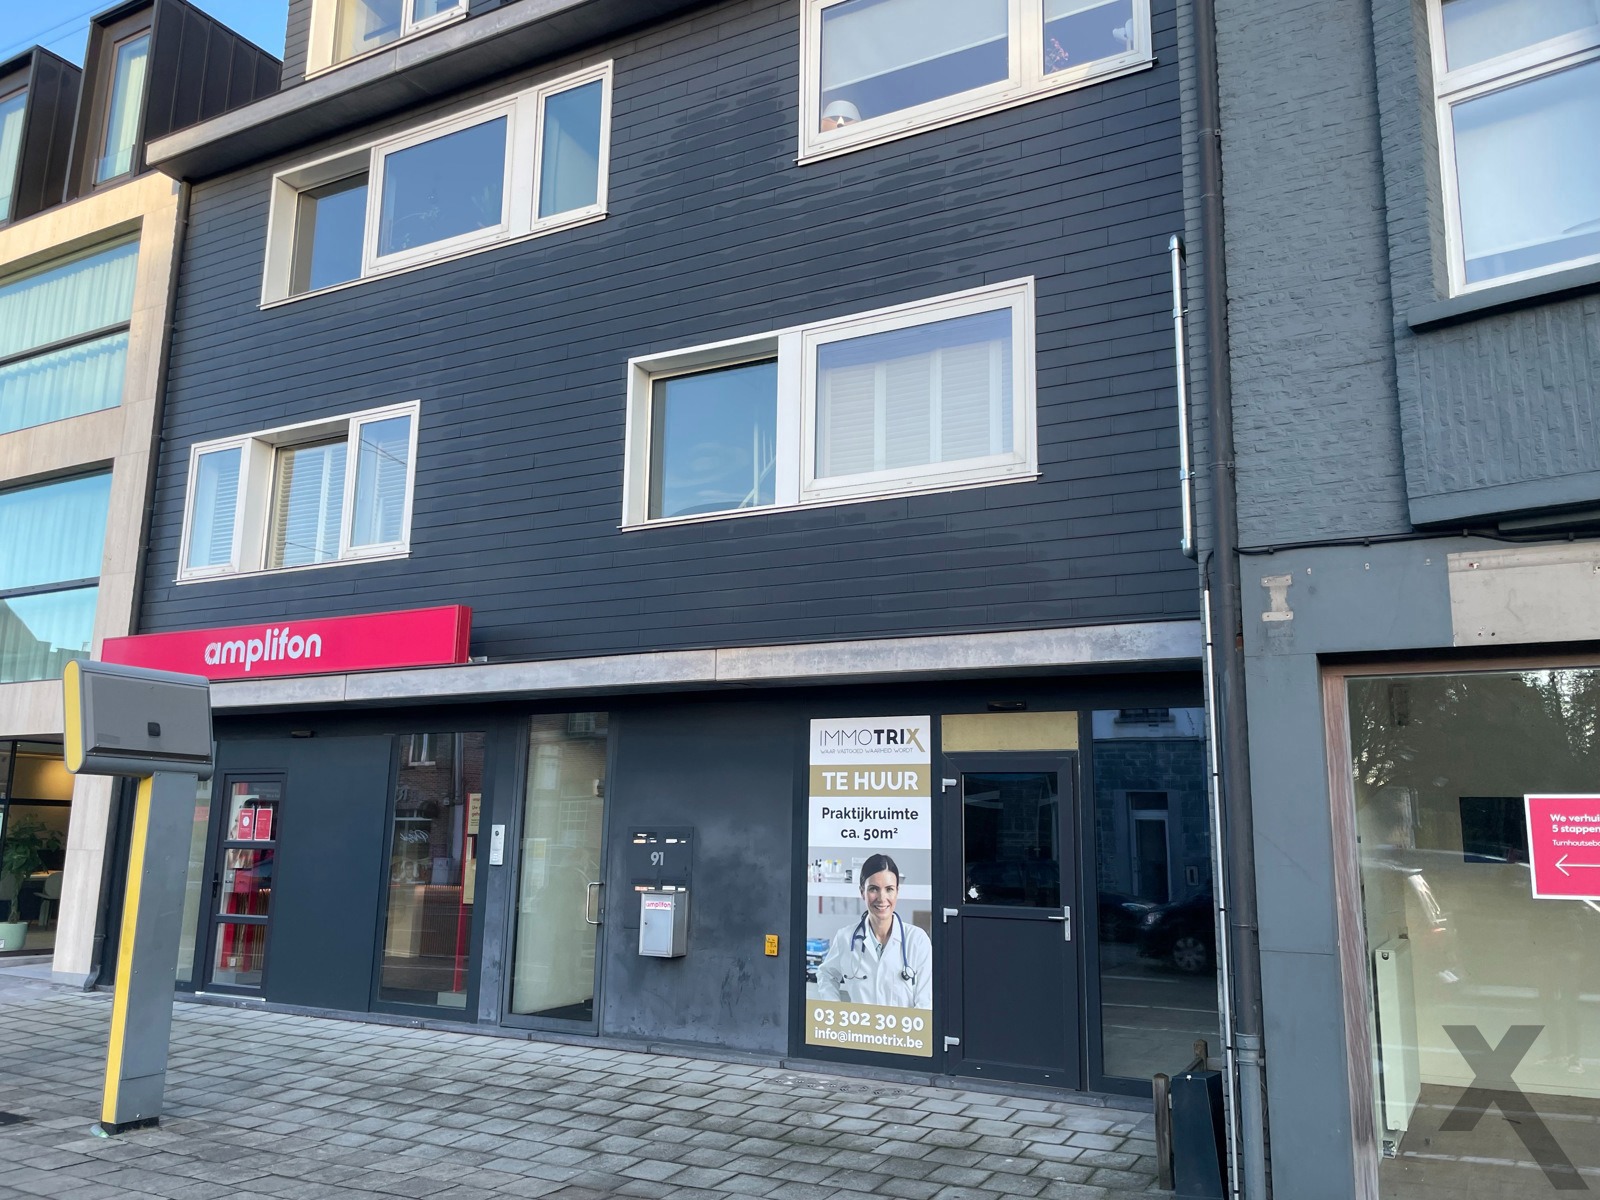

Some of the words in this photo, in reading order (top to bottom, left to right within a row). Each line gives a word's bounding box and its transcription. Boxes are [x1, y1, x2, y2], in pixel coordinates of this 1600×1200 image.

[204, 627, 322, 672] amplifon
[820, 728, 925, 752] IMMOTRIX
[822, 771, 848, 790] TE
[854, 771, 918, 790] HUUR
[822, 807, 919, 822] Praktijkruimte
[1550, 813, 1567, 822] We
[841, 829, 860, 838] ca.
[863, 828, 898, 841] 50m²
[1552, 824, 1559, 833] 5
[650, 851, 664, 866] 91
[814, 1008, 835, 1025] 03
[839, 1010, 871, 1027] 302
[875, 1013, 897, 1030] 30
[901, 1016, 924, 1033] 90
[814, 1027, 923, 1049] info@immotrix.be
